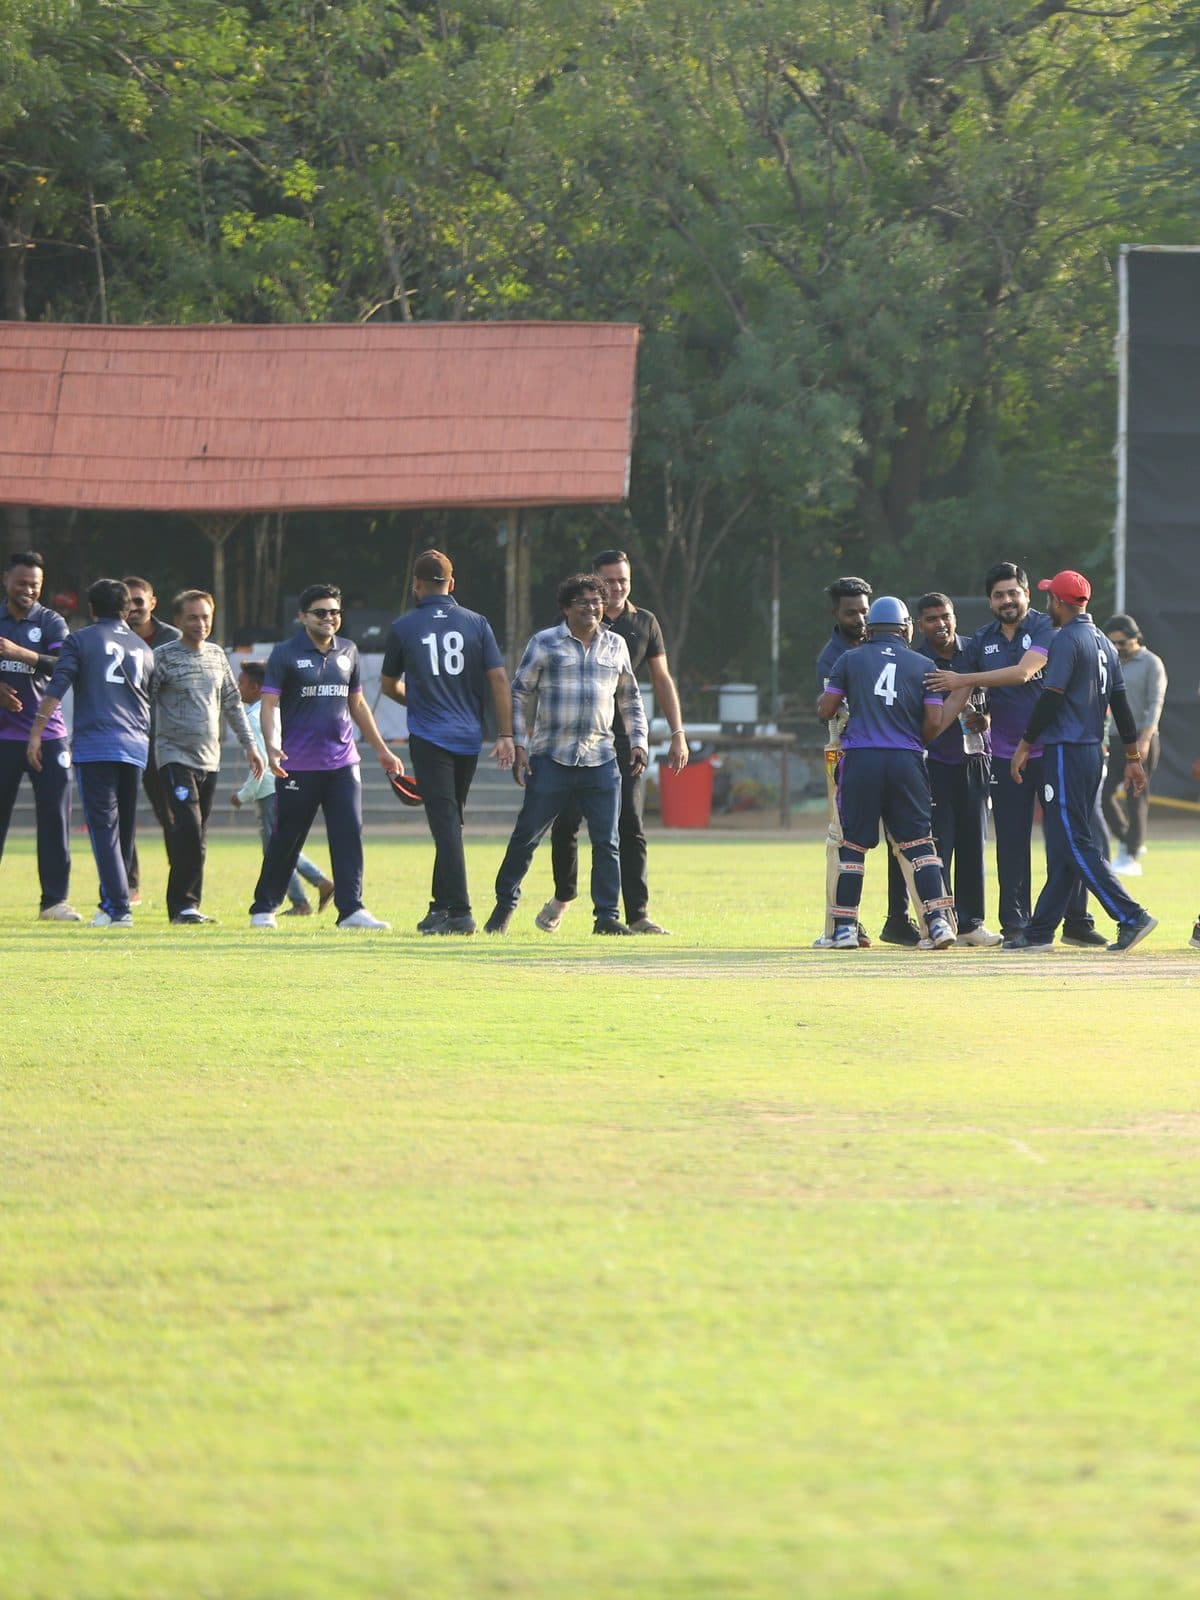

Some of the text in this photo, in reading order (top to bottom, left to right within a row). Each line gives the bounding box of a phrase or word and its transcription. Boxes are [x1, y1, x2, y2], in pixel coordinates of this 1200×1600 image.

[105, 641, 144, 689] 21
[422, 630, 465, 676] 18
[301, 685, 317, 698] SIM
[874, 662, 898, 706] 4
